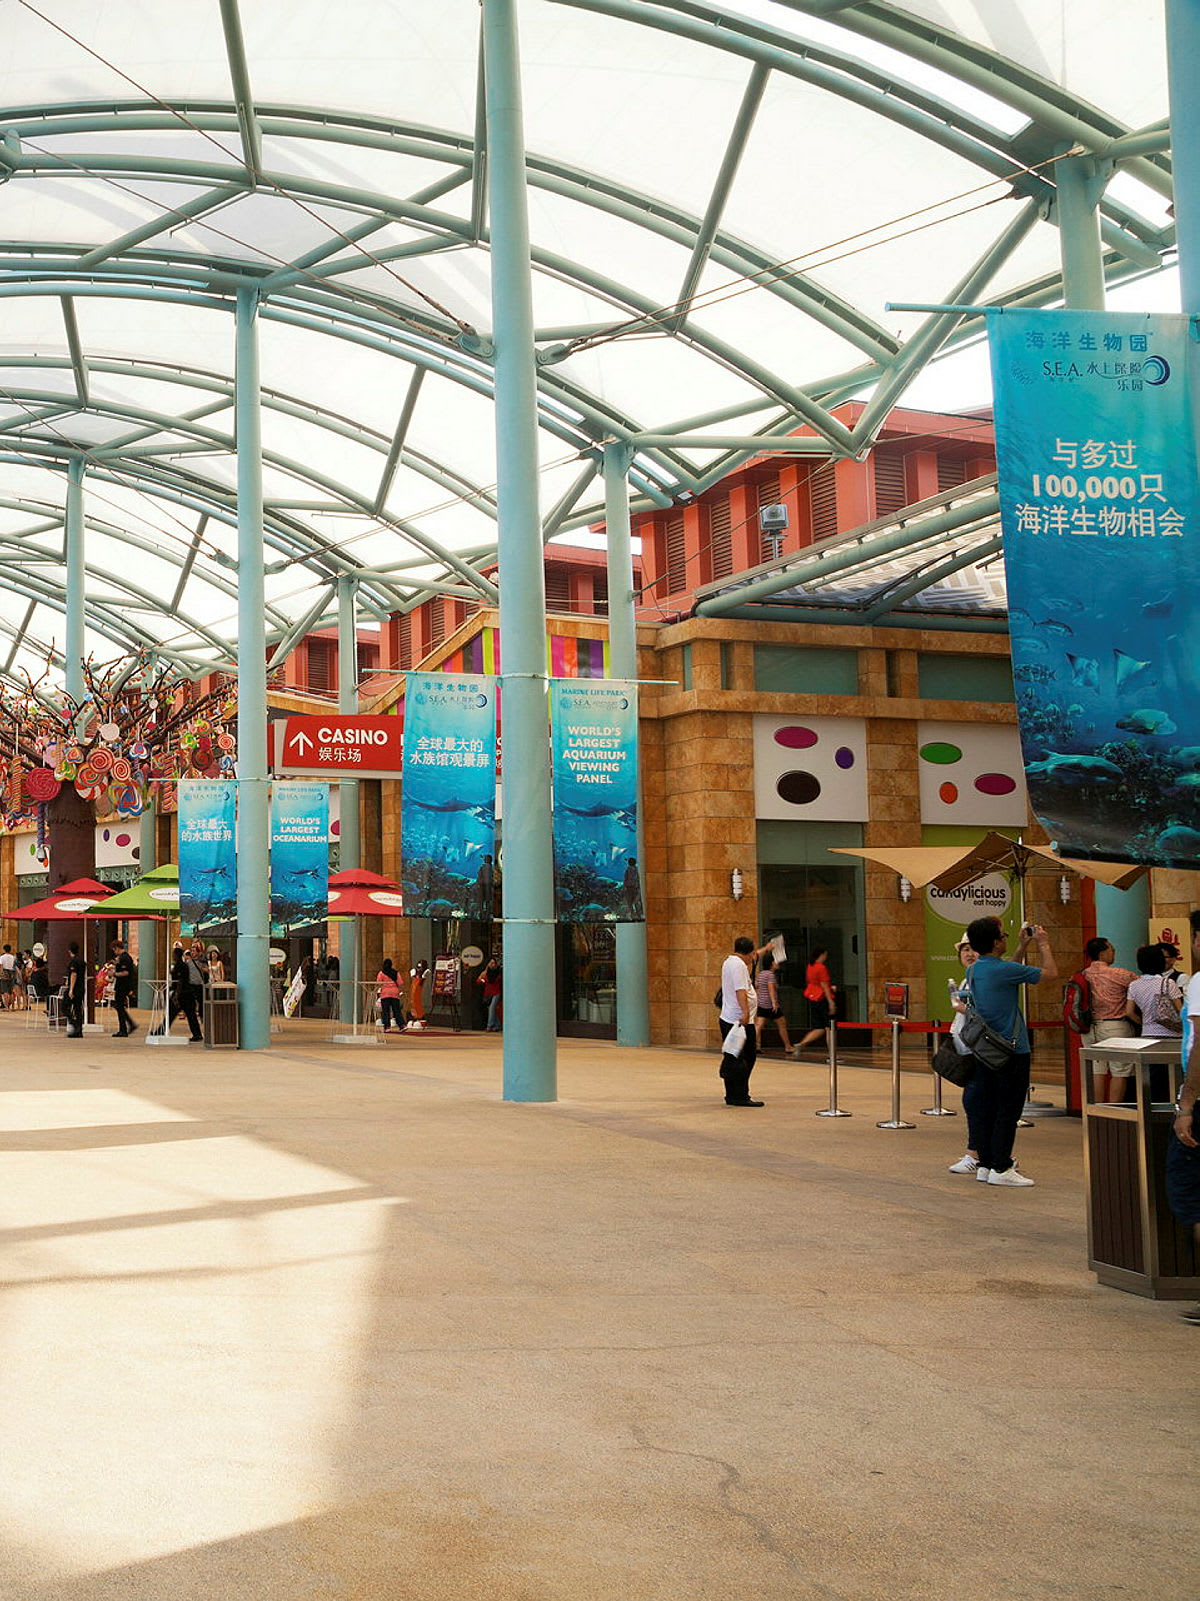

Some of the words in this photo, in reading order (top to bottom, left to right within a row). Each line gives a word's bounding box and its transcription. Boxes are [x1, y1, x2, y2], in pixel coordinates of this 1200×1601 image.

[1026, 331, 1148, 352] 海洋生物园
[1043, 361, 1083, 377] S.E.A.
[1052, 438, 1138, 469] 与多过
[1032, 474, 1167, 503] 100,000只
[1015, 503, 1186, 538] 海洋生物相会
[317, 728, 388, 746] CASINO
[567, 726, 621, 737] WORLD'S
[416, 736, 483, 753] 全球最大的
[568, 738, 621, 748] LARGEST
[318, 747, 362, 763] 娱乐场
[409, 751, 490, 768] 水族馆观景屏
[562, 750, 627, 761] AQUARIUM
[568, 761, 620, 772] VIEWING
[576, 773, 613, 784] PANEL
[187, 819, 228, 831] 全球最大
[280, 816, 321, 826] WORLD'S
[280, 826, 320, 834] LARGEST
[181, 830, 233, 843] 的水族世界
[273, 834, 327, 844] OCEANARIUM
[985, 899, 1007, 908] happy
